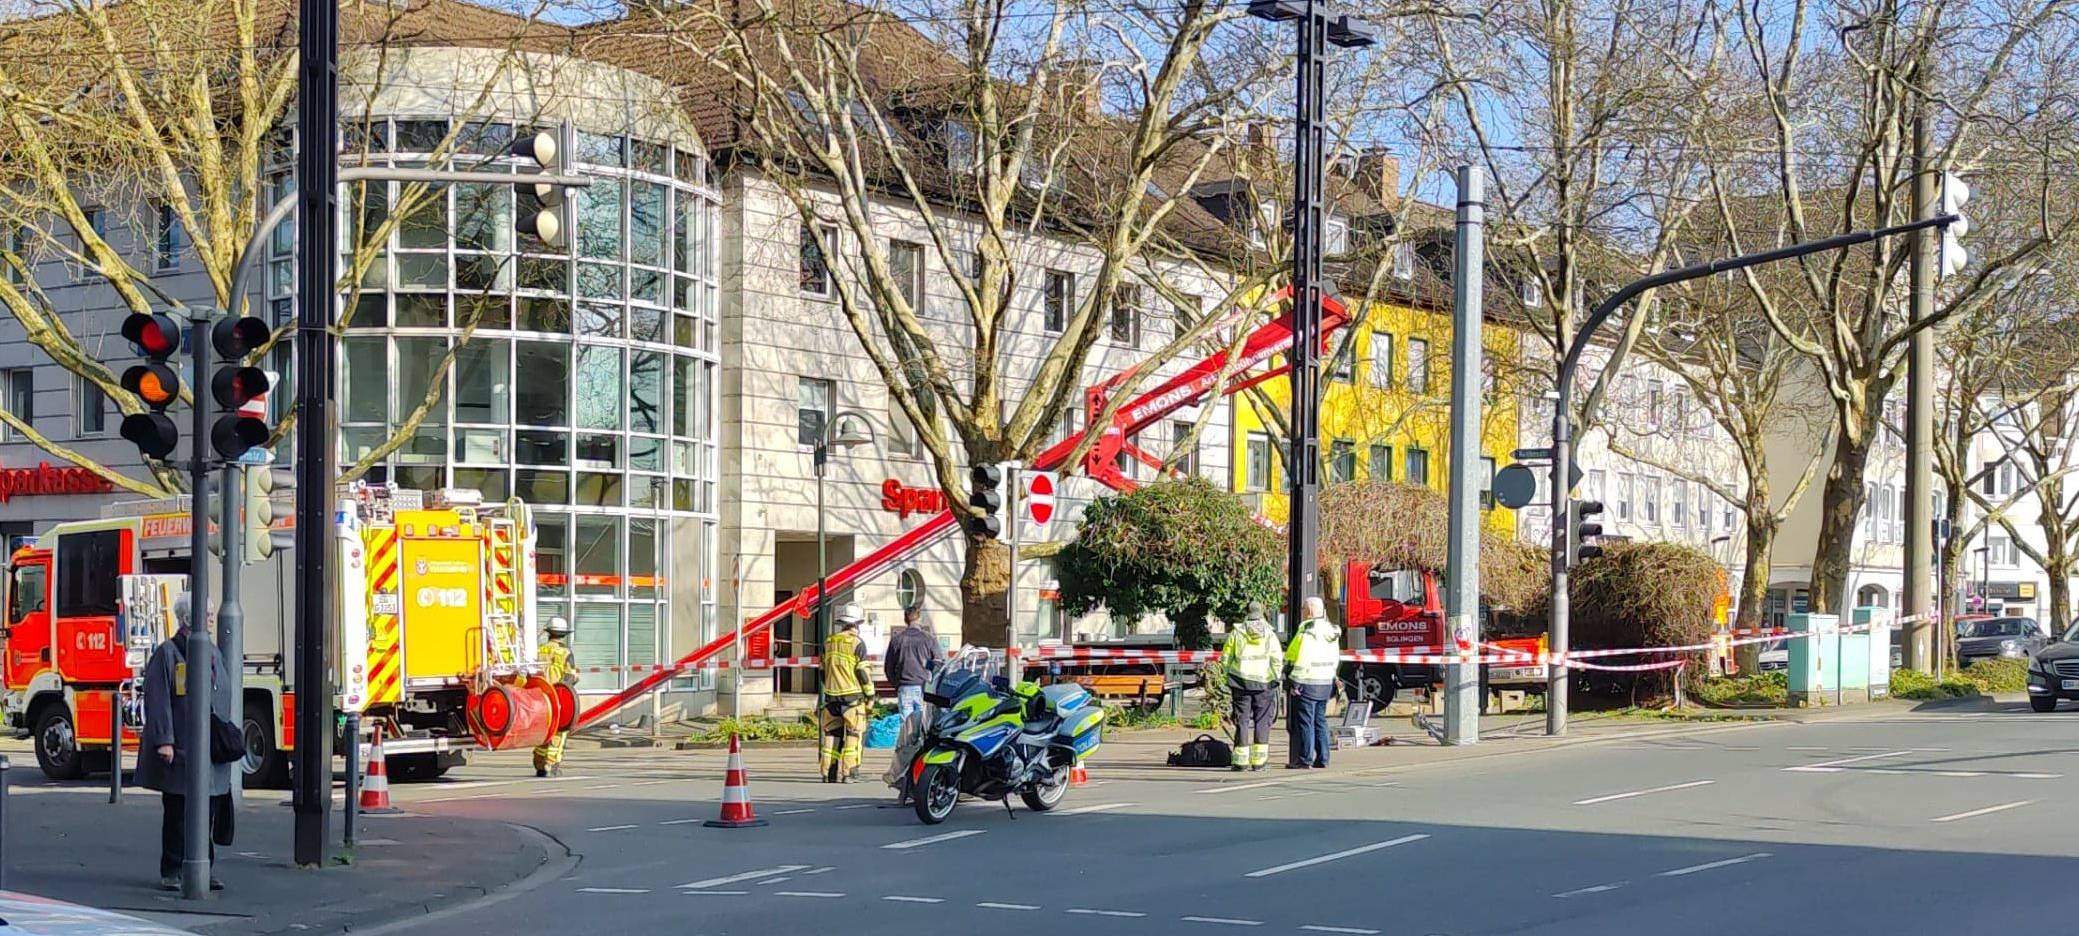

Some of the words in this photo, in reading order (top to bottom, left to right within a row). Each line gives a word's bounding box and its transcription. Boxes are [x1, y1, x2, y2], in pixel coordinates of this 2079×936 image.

[1131, 385, 1193, 420] EMONS
[144, 516, 193, 537] FEUERW
[438, 587, 468, 607] 112
[1378, 621, 1427, 630] EMONS
[87, 633, 106, 649] 112
